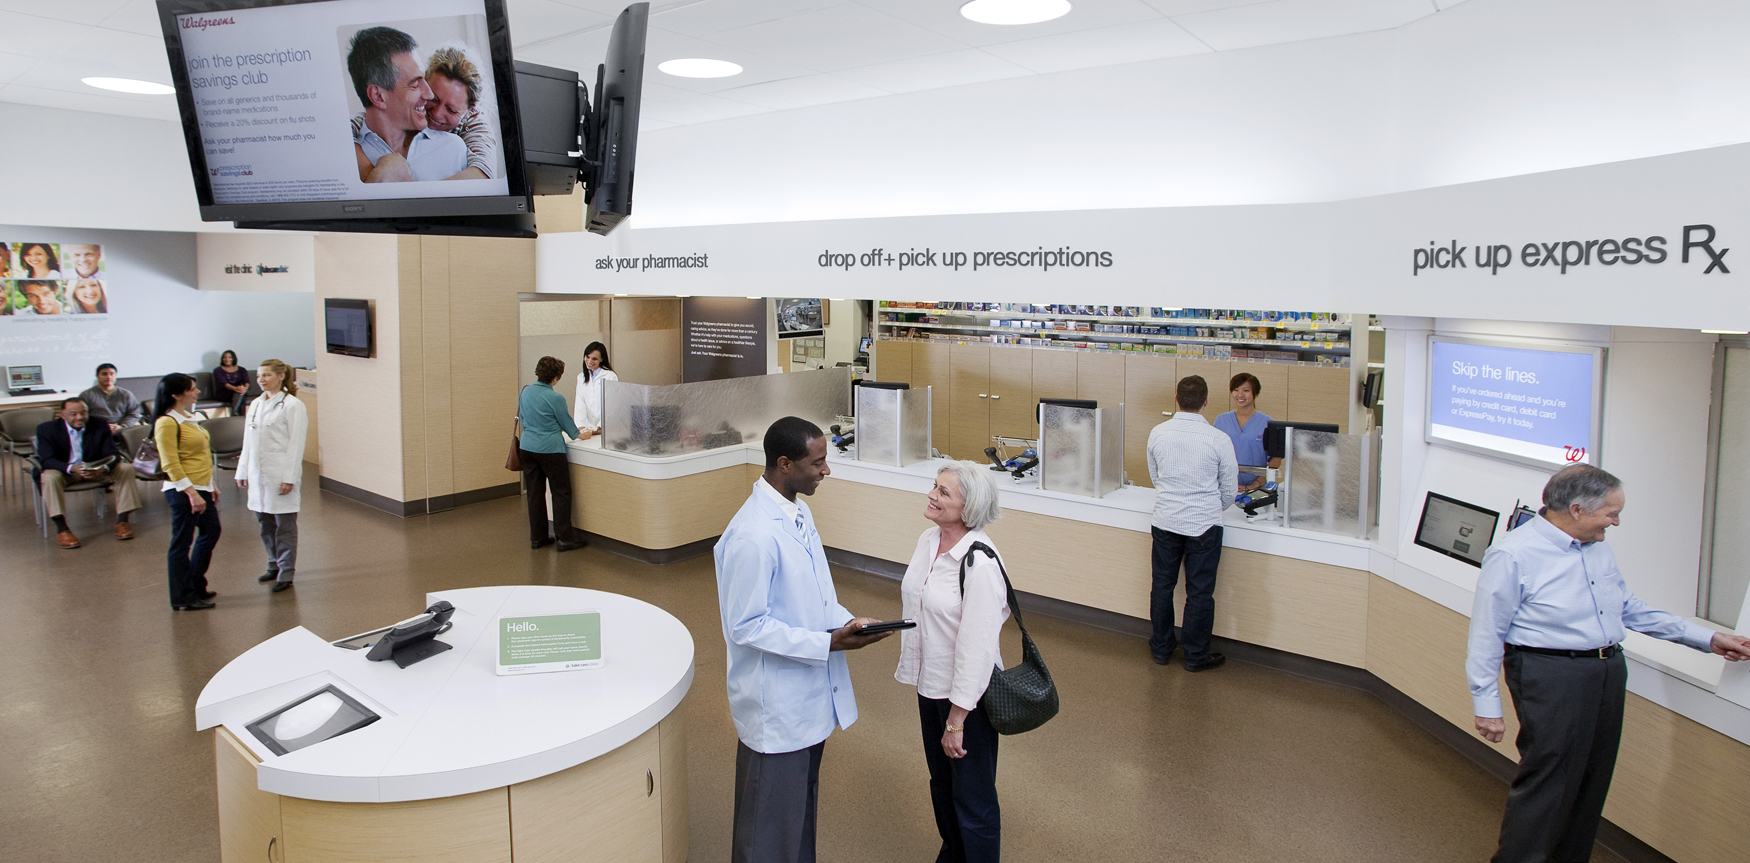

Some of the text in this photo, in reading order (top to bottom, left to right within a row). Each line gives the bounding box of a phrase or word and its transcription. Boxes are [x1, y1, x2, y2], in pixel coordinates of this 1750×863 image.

[180, 16, 236, 31] Walgreens
[188, 48, 312, 72] join the prescription
[192, 70, 268, 89] savings club
[235, 96, 261, 105] generics
[276, 93, 308, 101] thousands
[204, 105, 278, 116] brand-name medications
[232, 136, 267, 145] pharmacist
[595, 253, 708, 272] ask your pharmacist
[818, 250, 856, 271] drop
[899, 248, 937, 270] pick
[942, 251, 967, 271] up
[973, 246, 1113, 271] prescriptions
[1413, 240, 1467, 276] pick
[1475, 243, 1512, 276] up
[1520, 235, 1668, 274] express
[1452, 360, 1540, 384] Skip the lines.
[1457, 386, 1477, 395] you've
[1478, 389, 1502, 399] ordered
[1504, 392, 1526, 402] ahead
[1527, 395, 1541, 404] and
[1542, 398, 1566, 408] you're
[1451, 397, 1556, 419] paying by credit card, debit card
[1459, 408, 1496, 423] ExpressPay,
[1497, 415, 1506, 424] try
[1513, 417, 1534, 430] today.
[507, 622, 539, 632] Hello.
